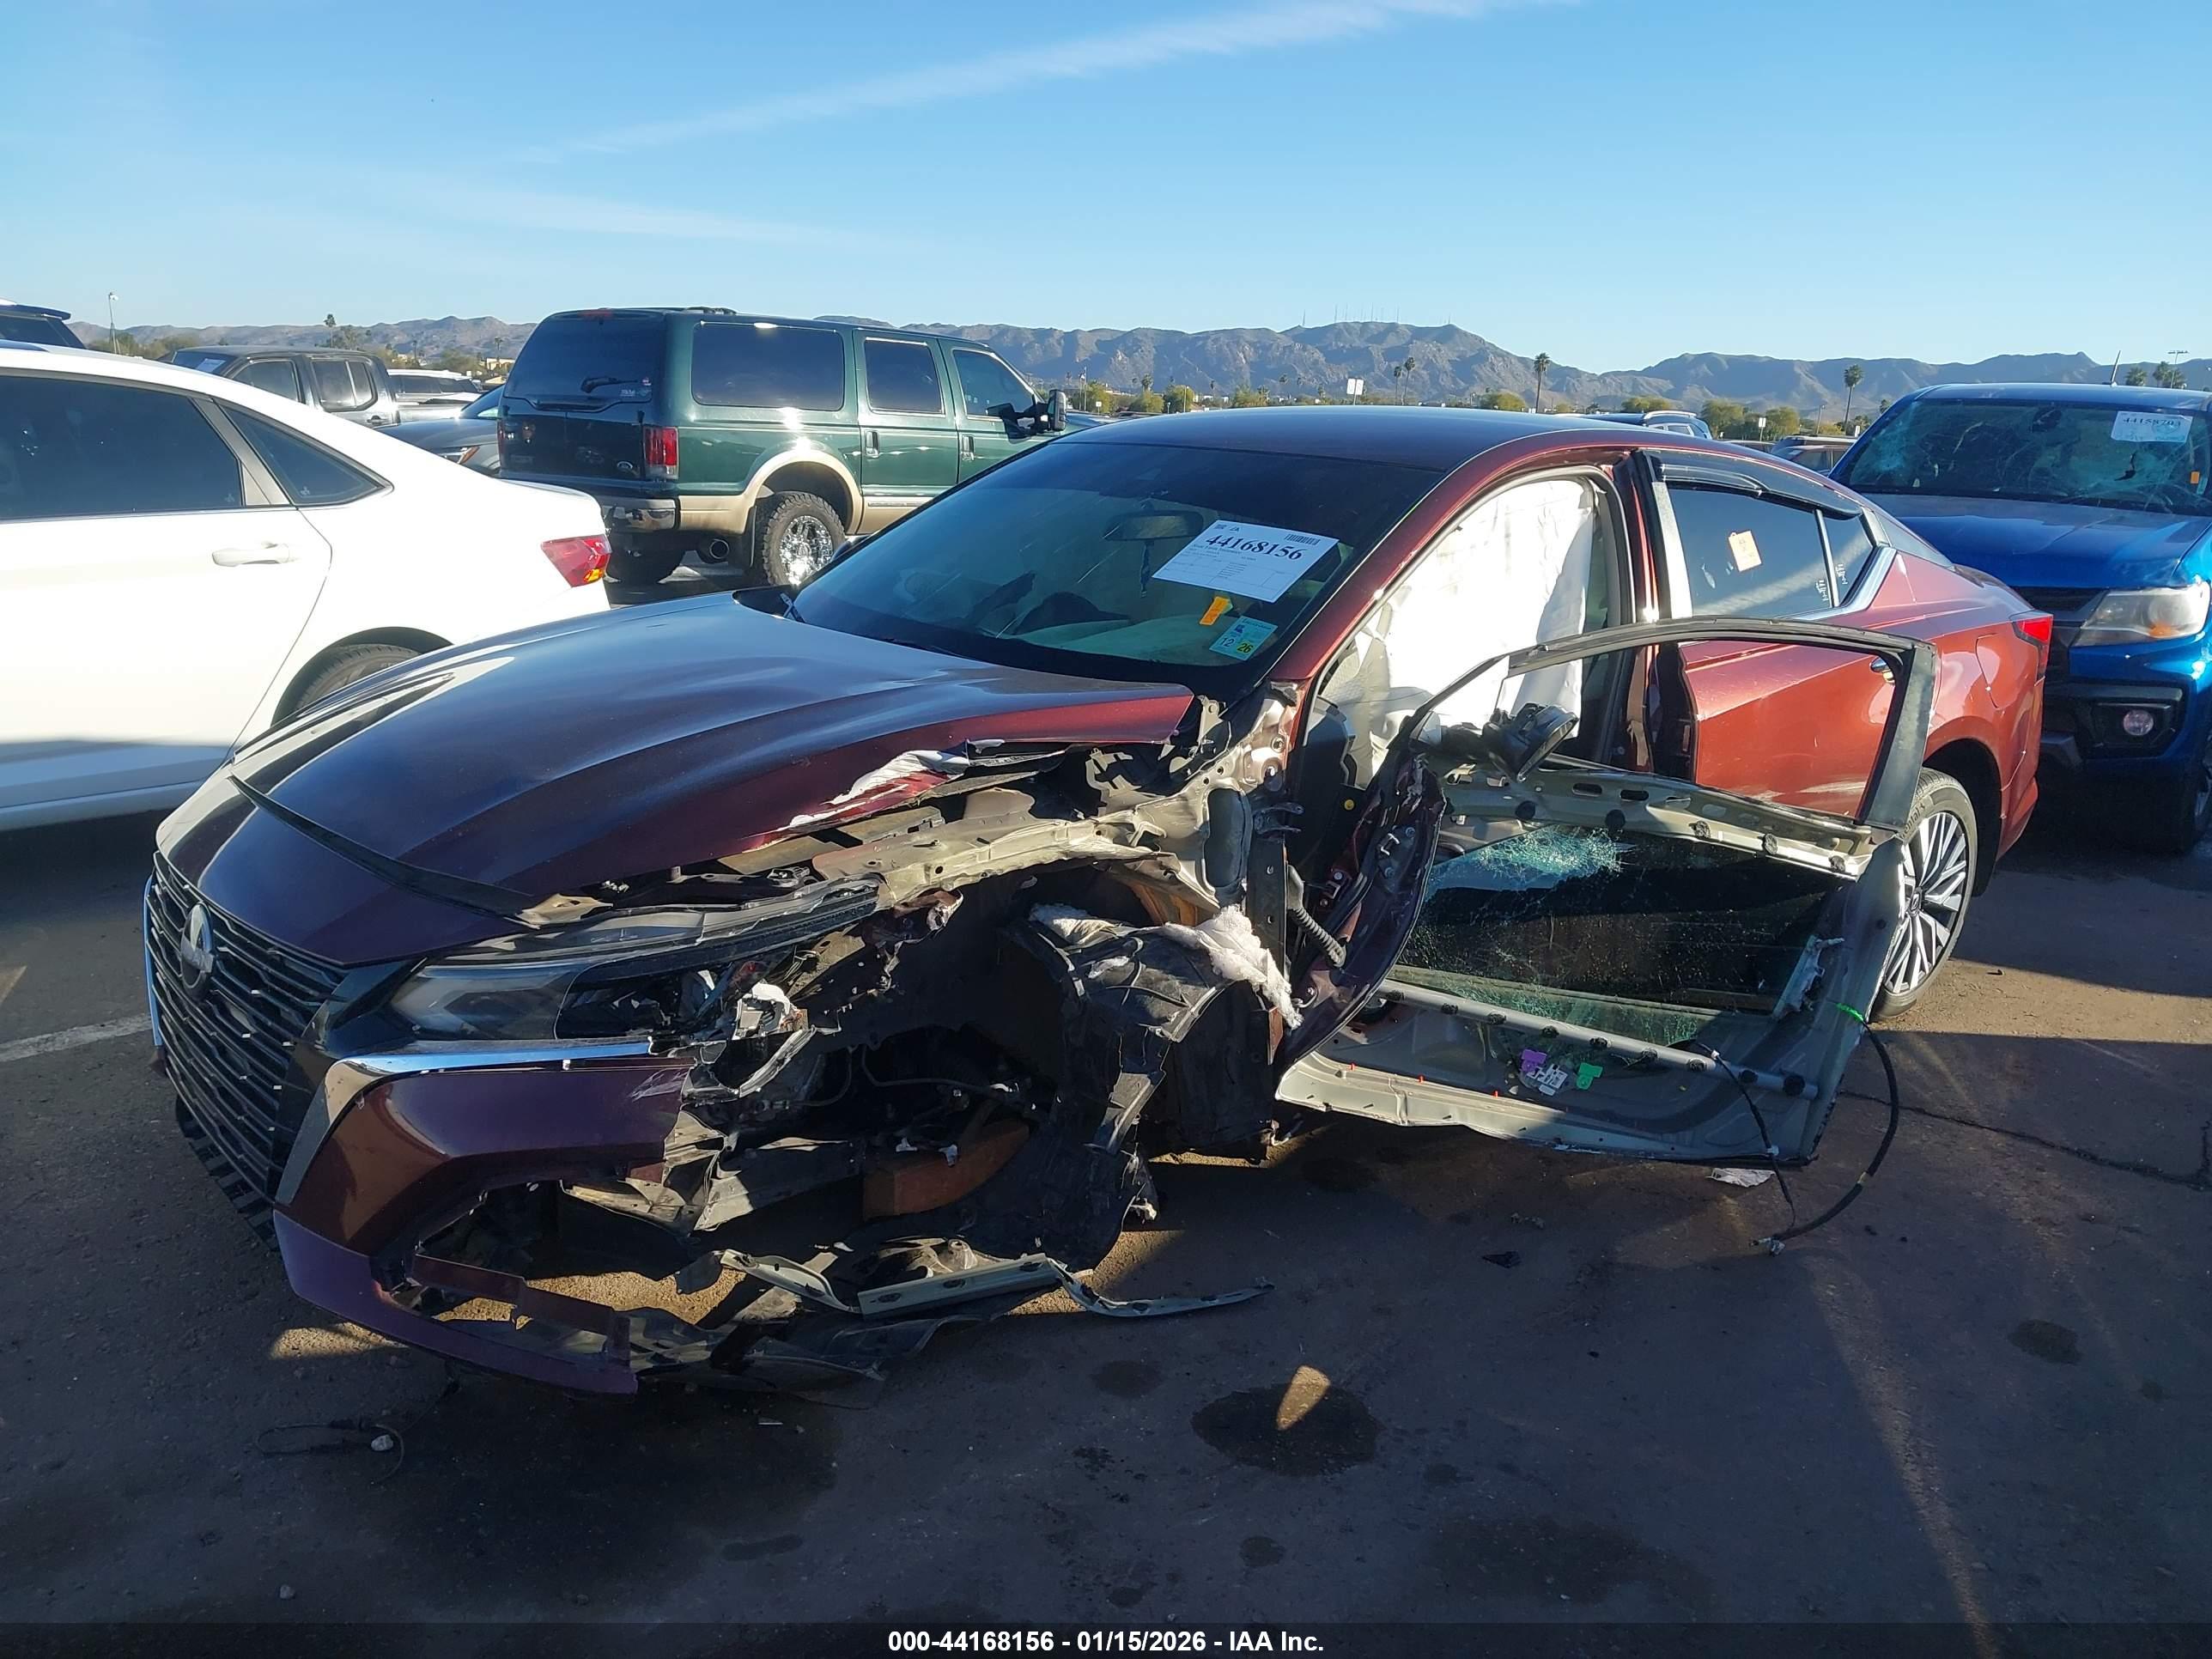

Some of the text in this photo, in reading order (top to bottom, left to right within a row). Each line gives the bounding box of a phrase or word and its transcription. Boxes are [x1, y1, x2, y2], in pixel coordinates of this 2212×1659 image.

[1206, 534, 1308, 560] 44168156
[1221, 637, 1235, 647] 12
[1237, 642, 1254, 653] 26
